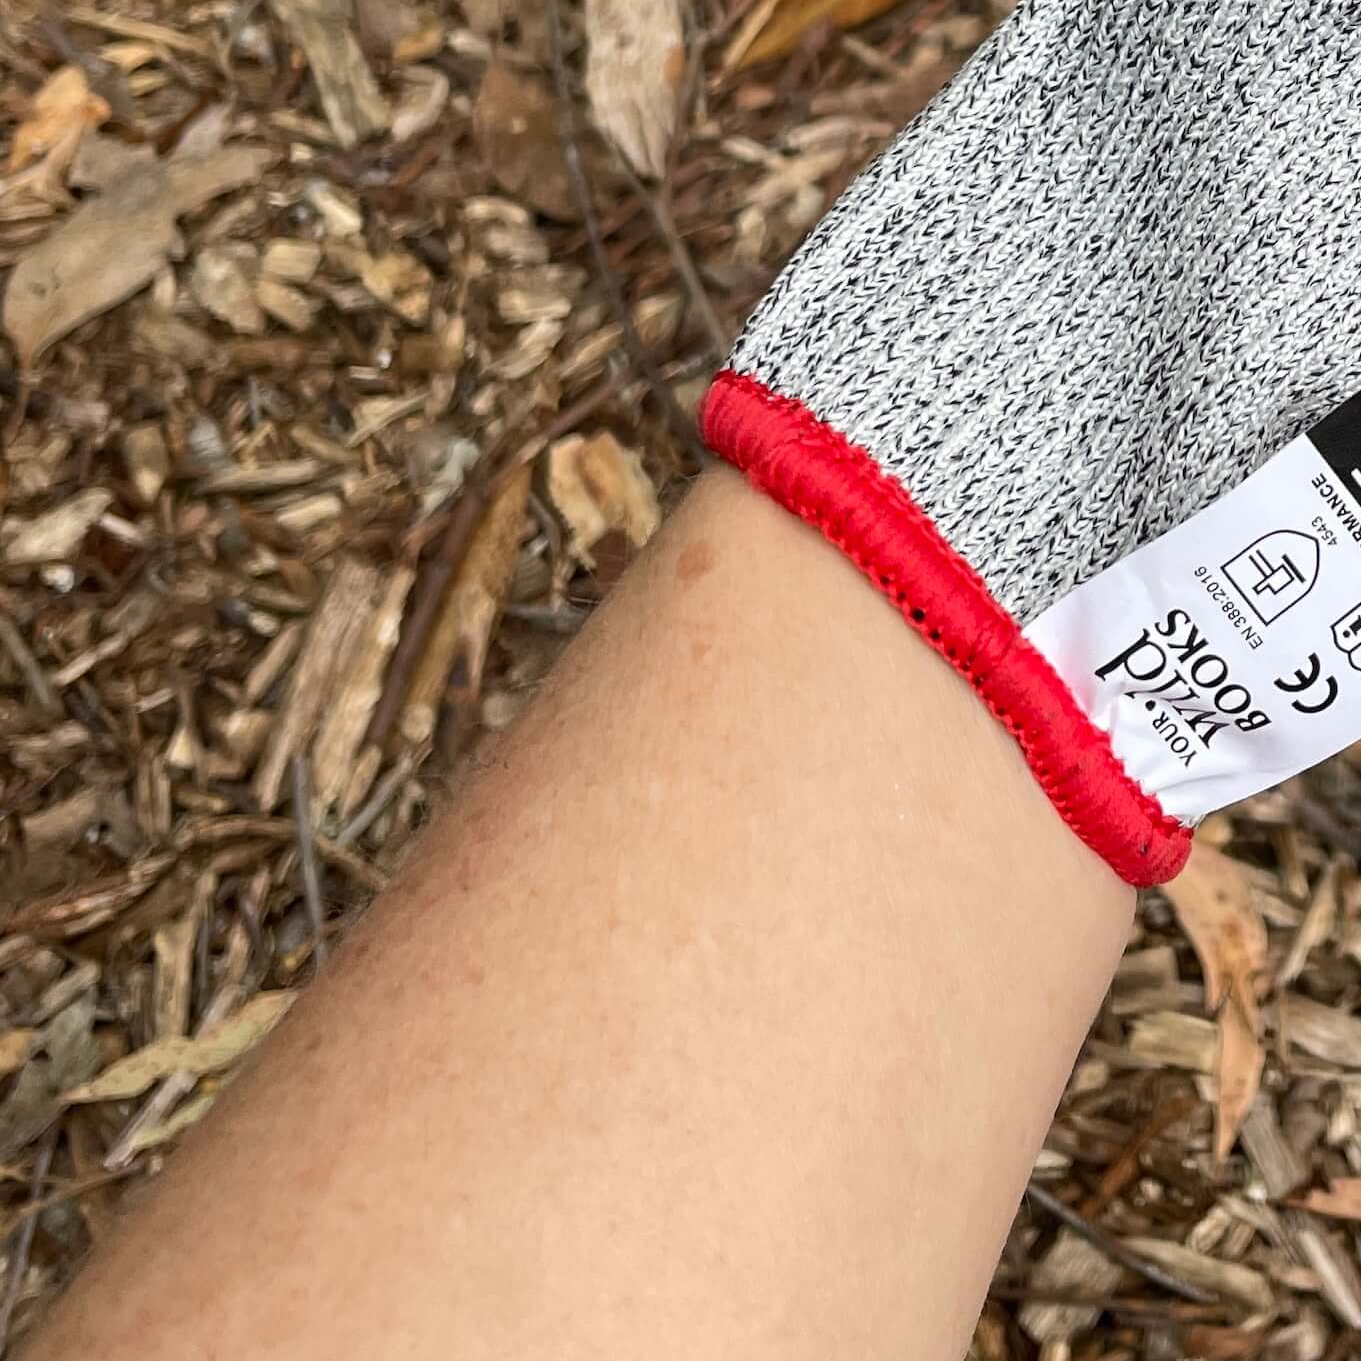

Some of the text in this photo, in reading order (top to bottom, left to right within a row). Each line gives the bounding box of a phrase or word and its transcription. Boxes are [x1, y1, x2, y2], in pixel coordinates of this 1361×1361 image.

[1311, 515, 1338, 546] 4543
[1194, 566, 1264, 649] EN 388:2016
[1155, 608, 1272, 731] BOOKS
[1274, 653, 1339, 713] CE
[1152, 711, 1197, 767] YOUR
